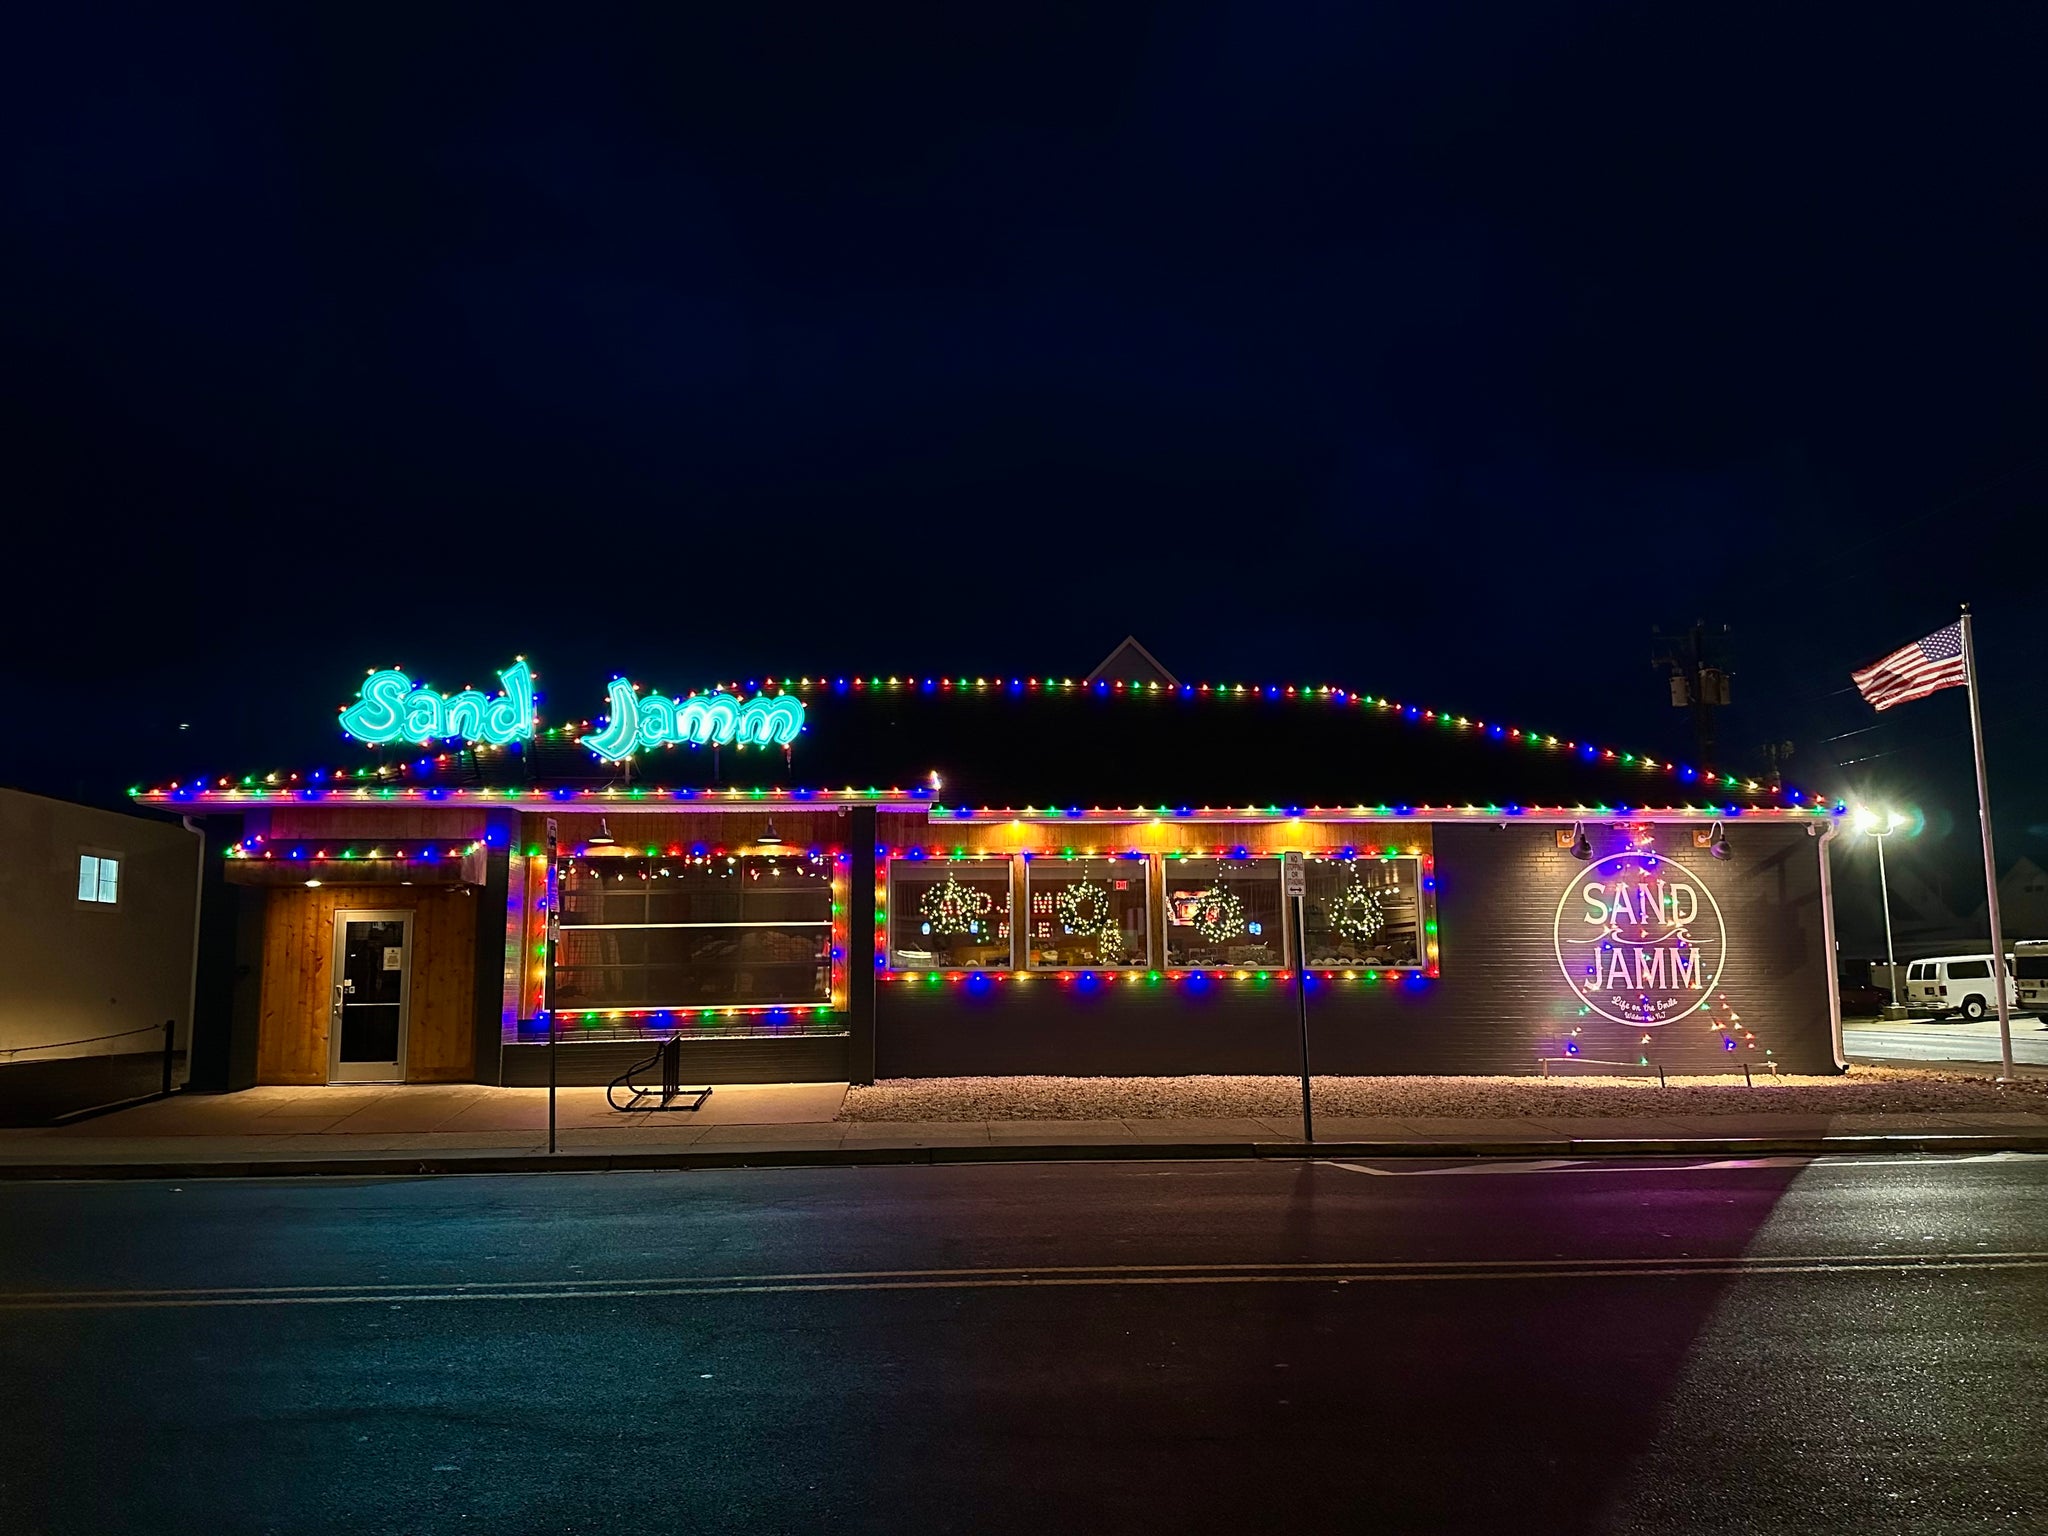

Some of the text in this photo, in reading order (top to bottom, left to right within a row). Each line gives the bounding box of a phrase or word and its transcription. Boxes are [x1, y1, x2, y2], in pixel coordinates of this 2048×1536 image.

[339, 660, 805, 761] Sand Jamm
[1582, 882, 1698, 925] SAND
[1584, 948, 1703, 990] JAMM
[1611, 995, 1630, 1011] Life
